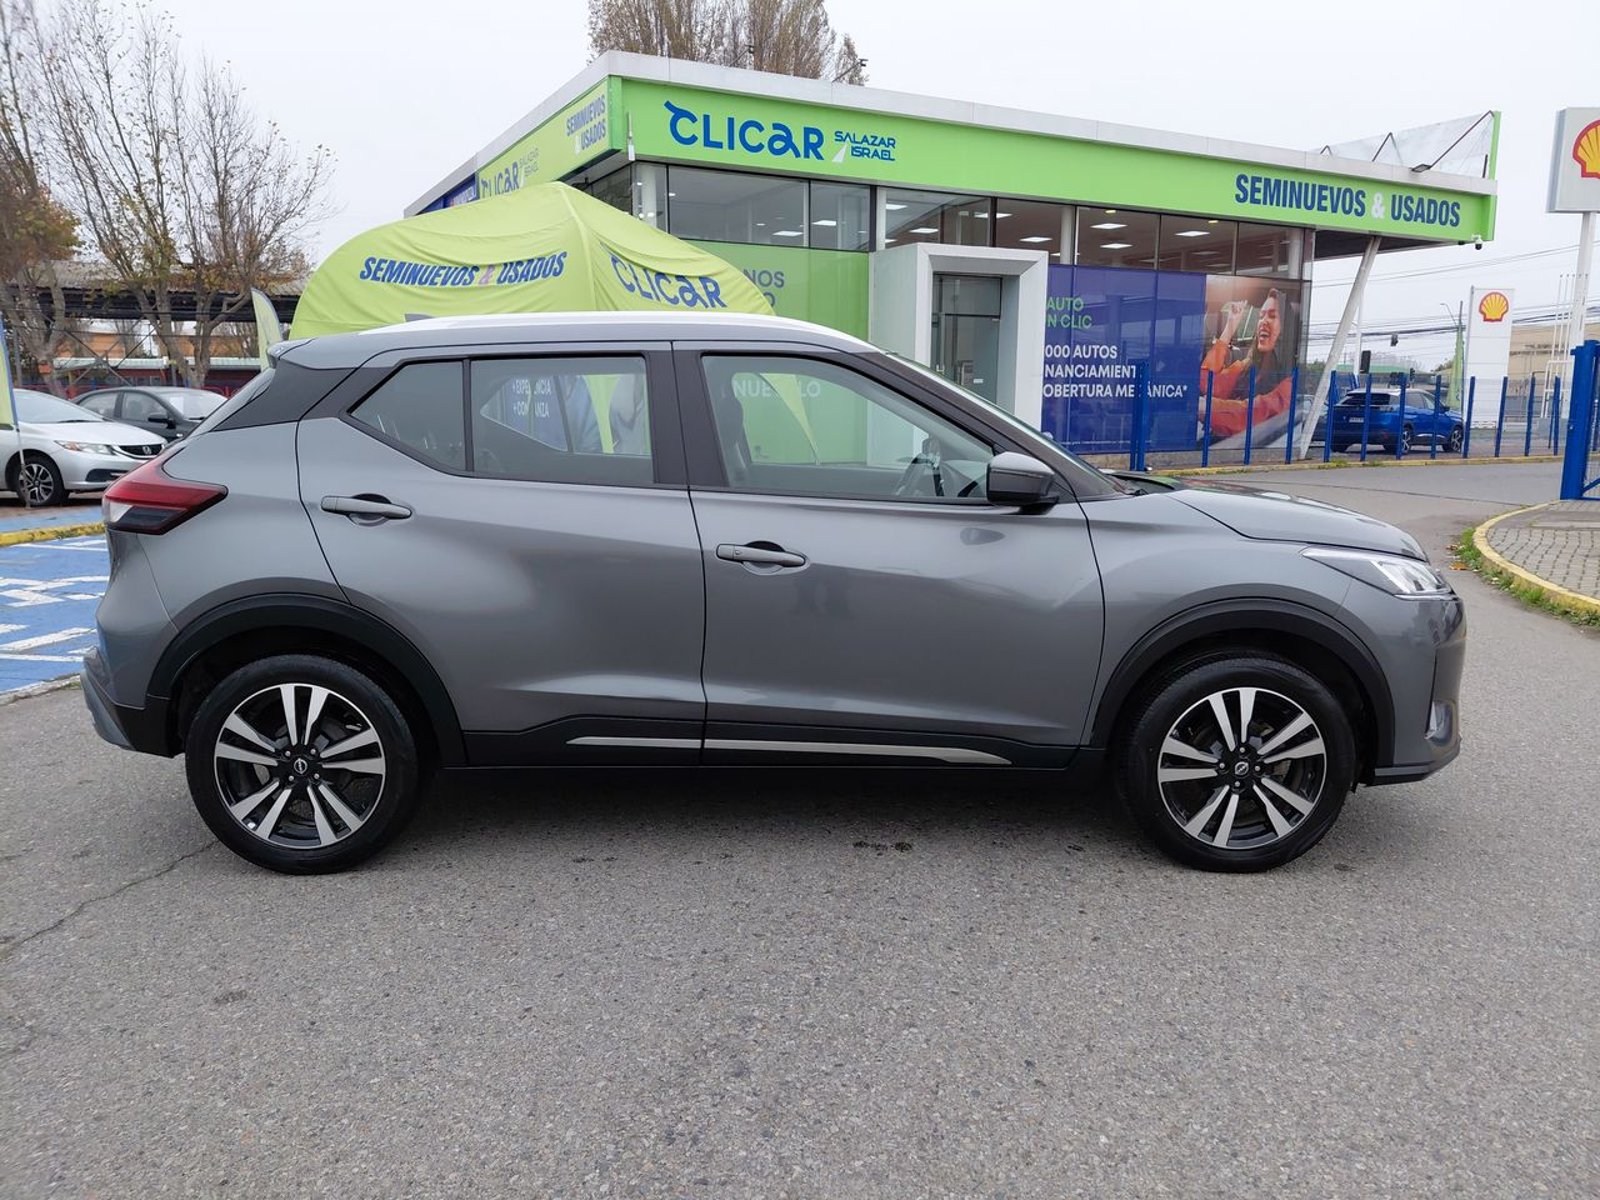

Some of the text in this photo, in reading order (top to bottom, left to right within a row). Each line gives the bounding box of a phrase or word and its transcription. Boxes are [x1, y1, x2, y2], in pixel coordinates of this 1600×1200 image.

[565, 94, 606, 137] SEMINUEVOS
[581, 118, 606, 150] USADOS
[834, 130, 896, 149] SALAZAR
[850, 145, 896, 161] ISRAEL
[1234, 173, 1461, 227] SEMINUEVOS & USADOS
[359, 251, 568, 287] SEMINUEVOS & USADOS
[1047, 296, 1084, 312] AUTO
[1047, 314, 1092, 329] N CLIC
[1044, 344, 1118, 359] 000 AUTOS
[1044, 364, 1142, 378] NANCIAMIENT
[1042, 380, 1188, 398] OBERTURA MEÁNICA
